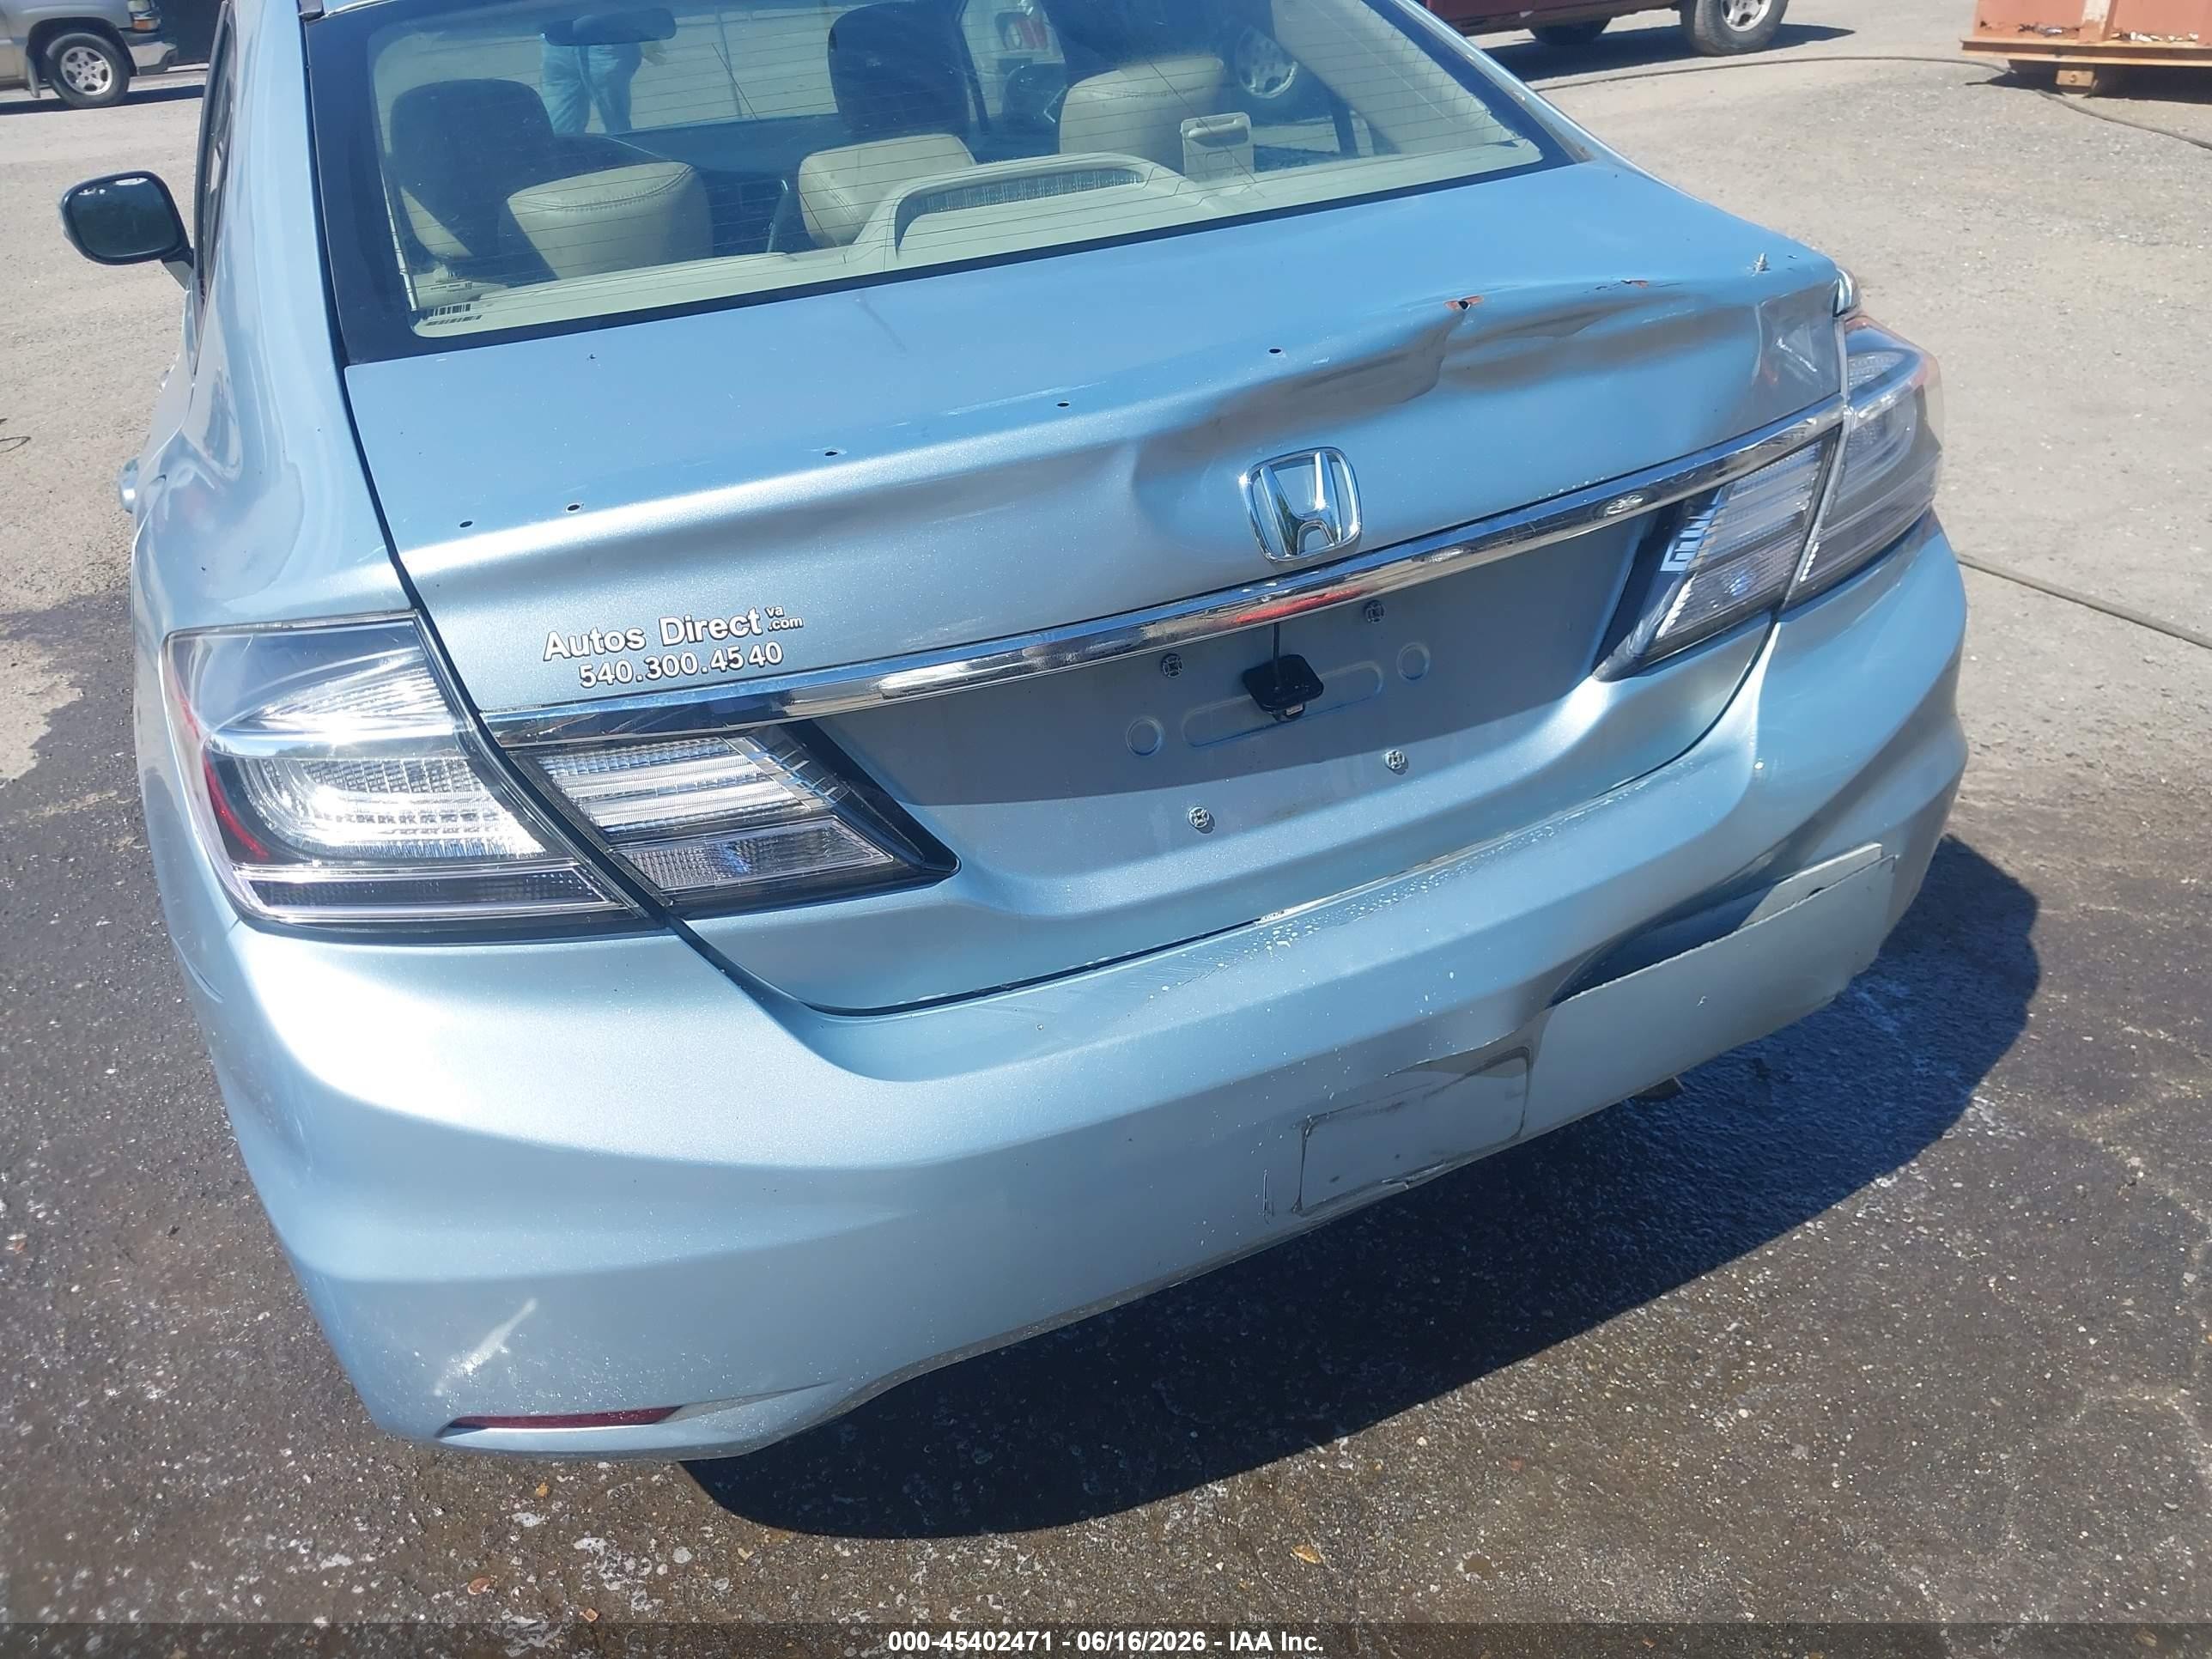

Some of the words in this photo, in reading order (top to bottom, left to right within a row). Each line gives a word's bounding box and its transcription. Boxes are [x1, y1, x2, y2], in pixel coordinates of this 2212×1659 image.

[765, 604, 784, 617] va
[767, 616, 805, 632] .com
[543, 627, 647, 661] Autos
[658, 605, 763, 647] Direct
